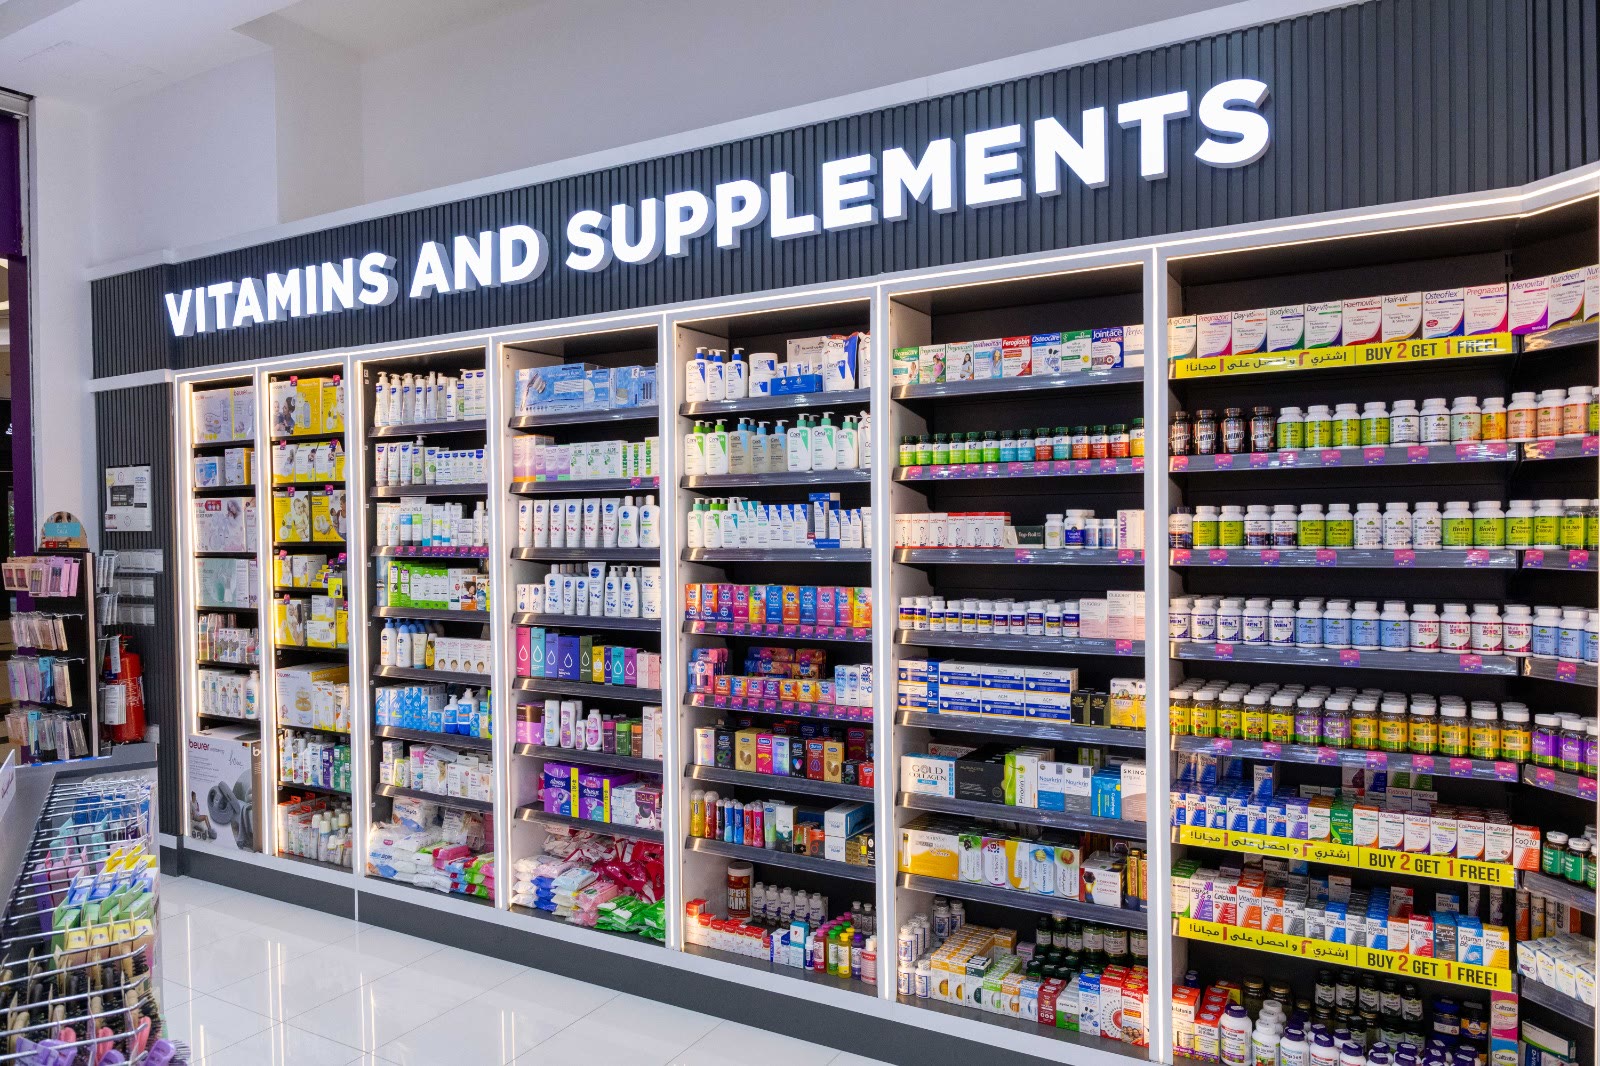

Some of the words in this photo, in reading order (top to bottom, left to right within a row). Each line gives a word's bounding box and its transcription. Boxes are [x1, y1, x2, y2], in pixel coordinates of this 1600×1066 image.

[164, 251, 398, 338] VITAMINS
[409, 224, 548, 300] AND
[565, 78, 1271, 272] SUPPLEMENTS
[1510, 278, 1547, 291] Menovital
[1424, 290, 1458, 302] Osteoflex
[1466, 285, 1506, 298] Pregnazon
[1383, 294, 1410, 304] Hair-vit
[1093, 329, 1122, 340] Jointace
[1365, 348, 1393, 362] BUY
[1396, 343, 1408, 359] 2
[1411, 342, 1438, 358] GET
[1443, 338, 1451, 355] 1
[1457, 337, 1498, 354] FREE!
[188, 739, 210, 751] beurer
[911, 764, 944, 775] GOLD
[908, 772, 947, 782] COLLAGEN
[1039, 775, 1063, 785] Nourkrin
[1065, 778, 1089, 789] Nourkrin
[1231, 837, 1254, 849] على
[1257, 840, 1290, 852] احصل
[1369, 852, 1396, 869] BUY
[1399, 854, 1411, 871] 2
[1414, 857, 1441, 876] GET
[1447, 860, 1454, 877] 1
[1459, 862, 1501, 883] FREE!
[1214, 892, 1236, 902] Calcium
[1238, 894, 1260, 904] Vitamin
[1263, 905, 1282, 914] Vitamin
[1230, 933, 1253, 943] على
[1410, 928, 1432, 937] Vitamin
[1256, 937, 1289, 949] احصل
[1459, 934, 1482, 944] Vitamin
[1313, 947, 1350, 961] إشتري
[1367, 952, 1394, 970] BUY
[1398, 954, 1409, 972] 2
[1412, 959, 1439, 977] GET
[1444, 962, 1452, 980] 1
[1457, 967, 1498, 987] FREE!
[1494, 1003, 1516, 1013] Caltrate
[1494, 1053, 1516, 1063] Caltrate
